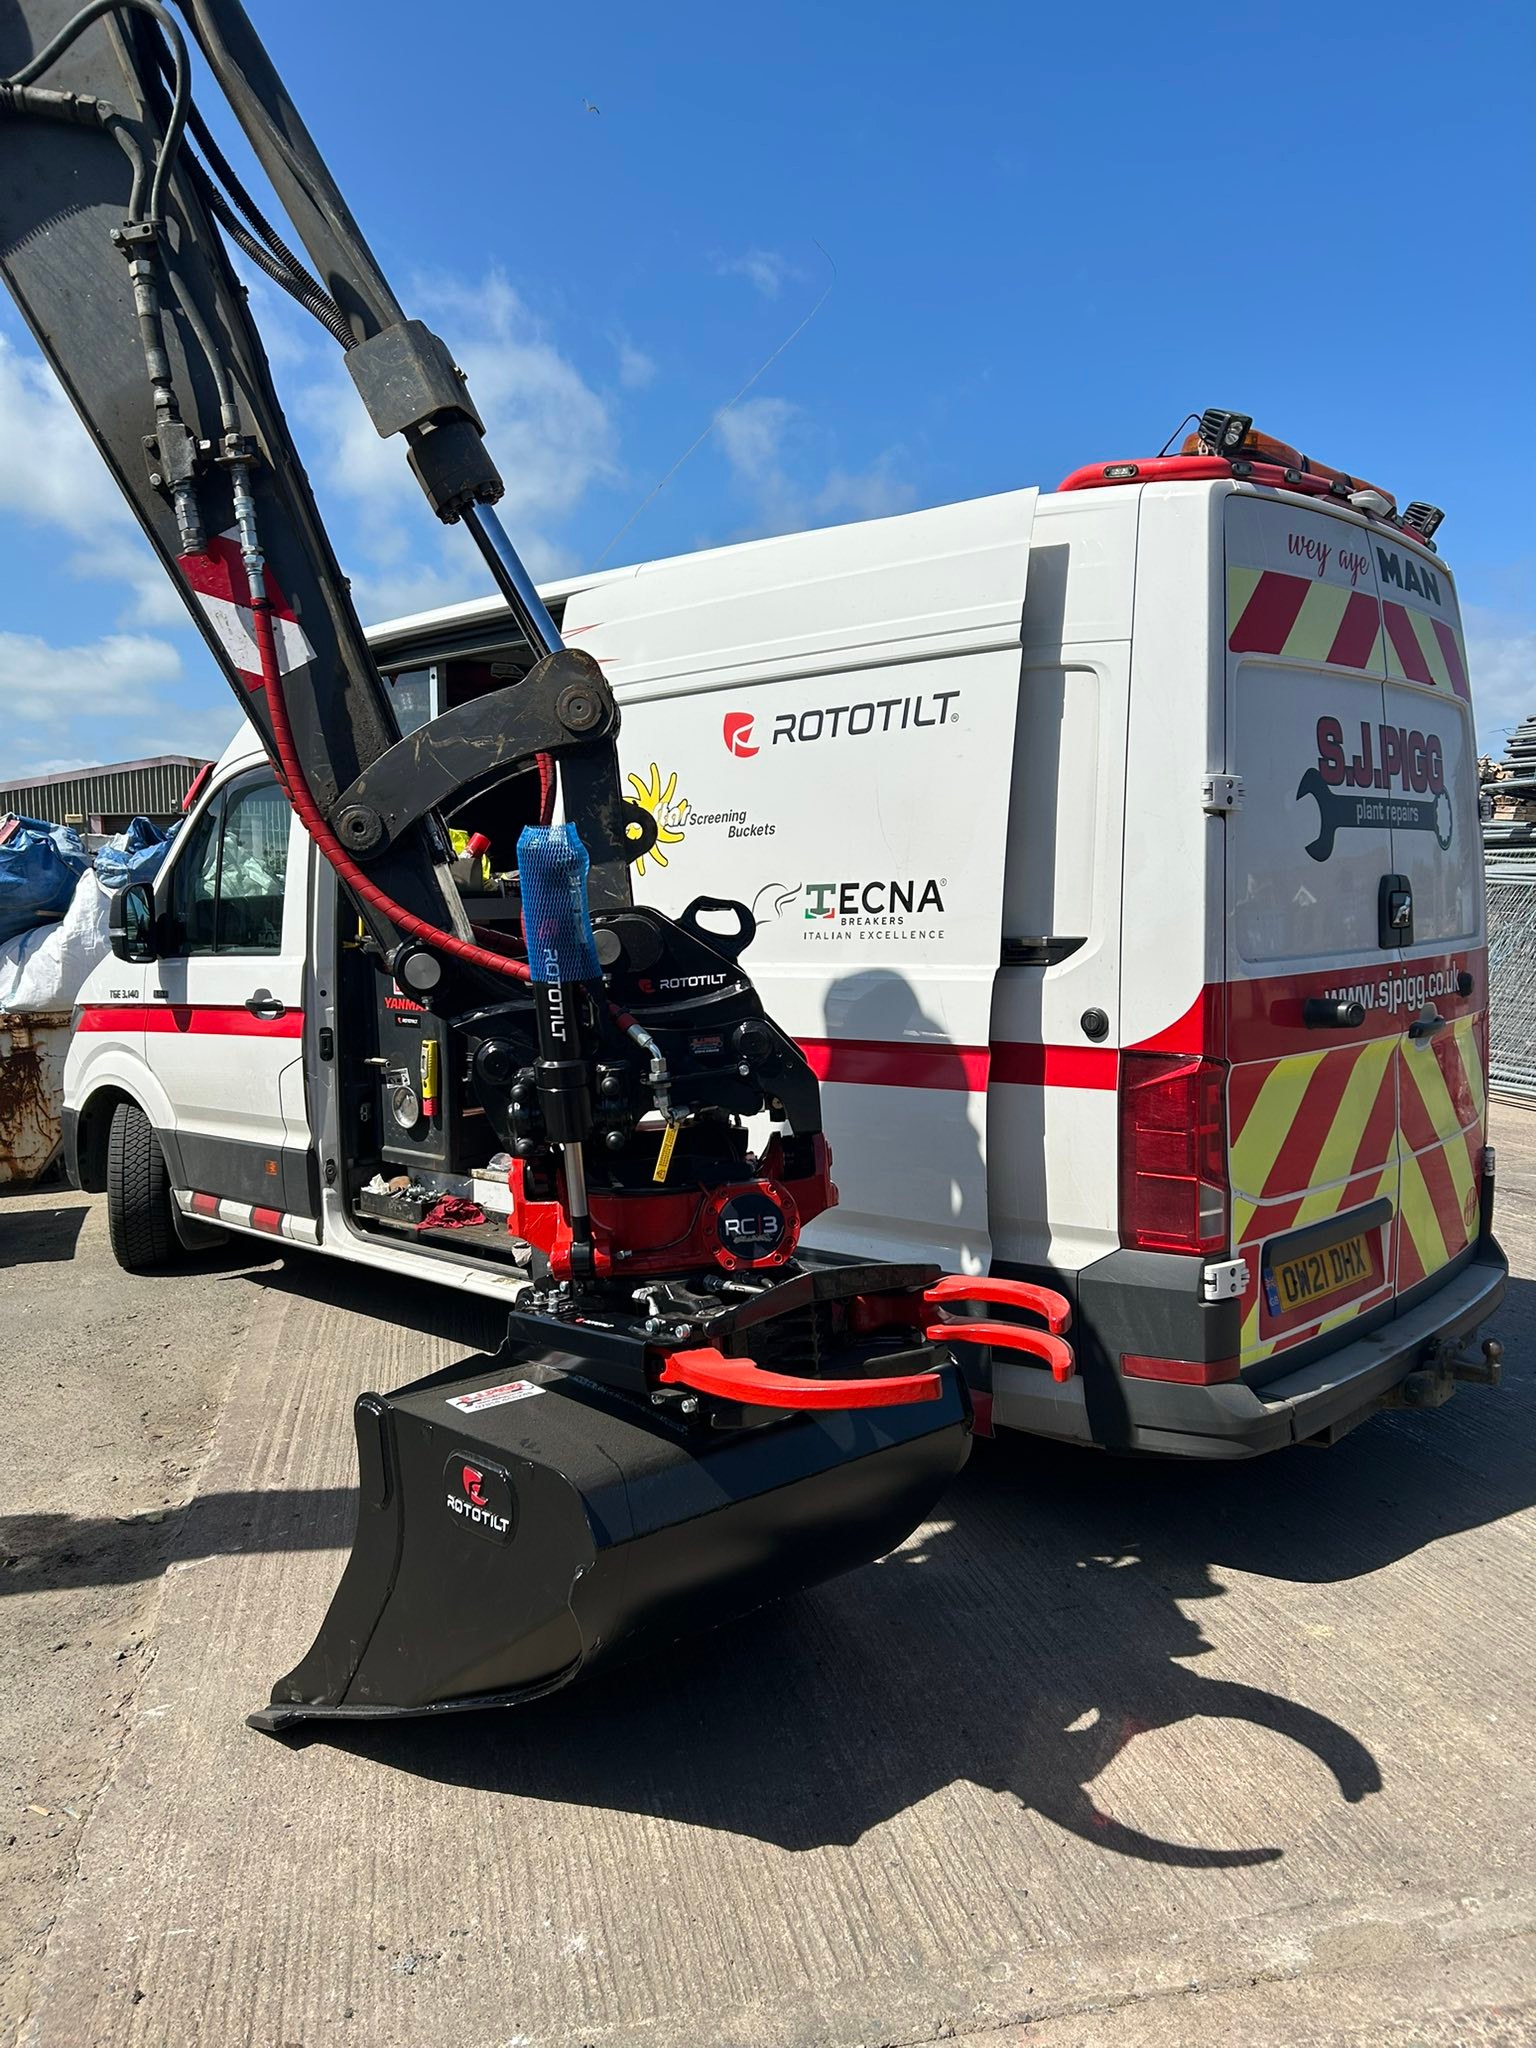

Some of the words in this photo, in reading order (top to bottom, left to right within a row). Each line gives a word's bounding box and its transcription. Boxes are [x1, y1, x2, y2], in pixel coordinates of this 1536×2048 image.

[1288, 532, 1331, 577] wey
[1338, 551, 1370, 587] aye
[1376, 546, 1442, 606] MAN
[772, 690, 961, 745] ROTOTILT
[1316, 716, 1445, 795] S.J.PIGG
[689, 809, 747, 826] Screening
[1356, 802, 1384, 825] plant
[1386, 805, 1420, 828] repairs
[727, 823, 776, 838] Buckets
[805, 879, 945, 917] TECNA
[840, 916, 904, 926] BREAKERS
[803, 930, 852, 941] ITALIAN
[859, 930, 945, 940] EXCELLENCE
[109, 989, 121, 999] TGE
[659, 973, 727, 990] ROTOTILT
[384, 997, 428, 1012] YANMA
[543, 948, 567, 1042] ROTOTILT
[1328, 1239, 1367, 1284] DHX
[446, 1493, 510, 1533] ROTOTILT
